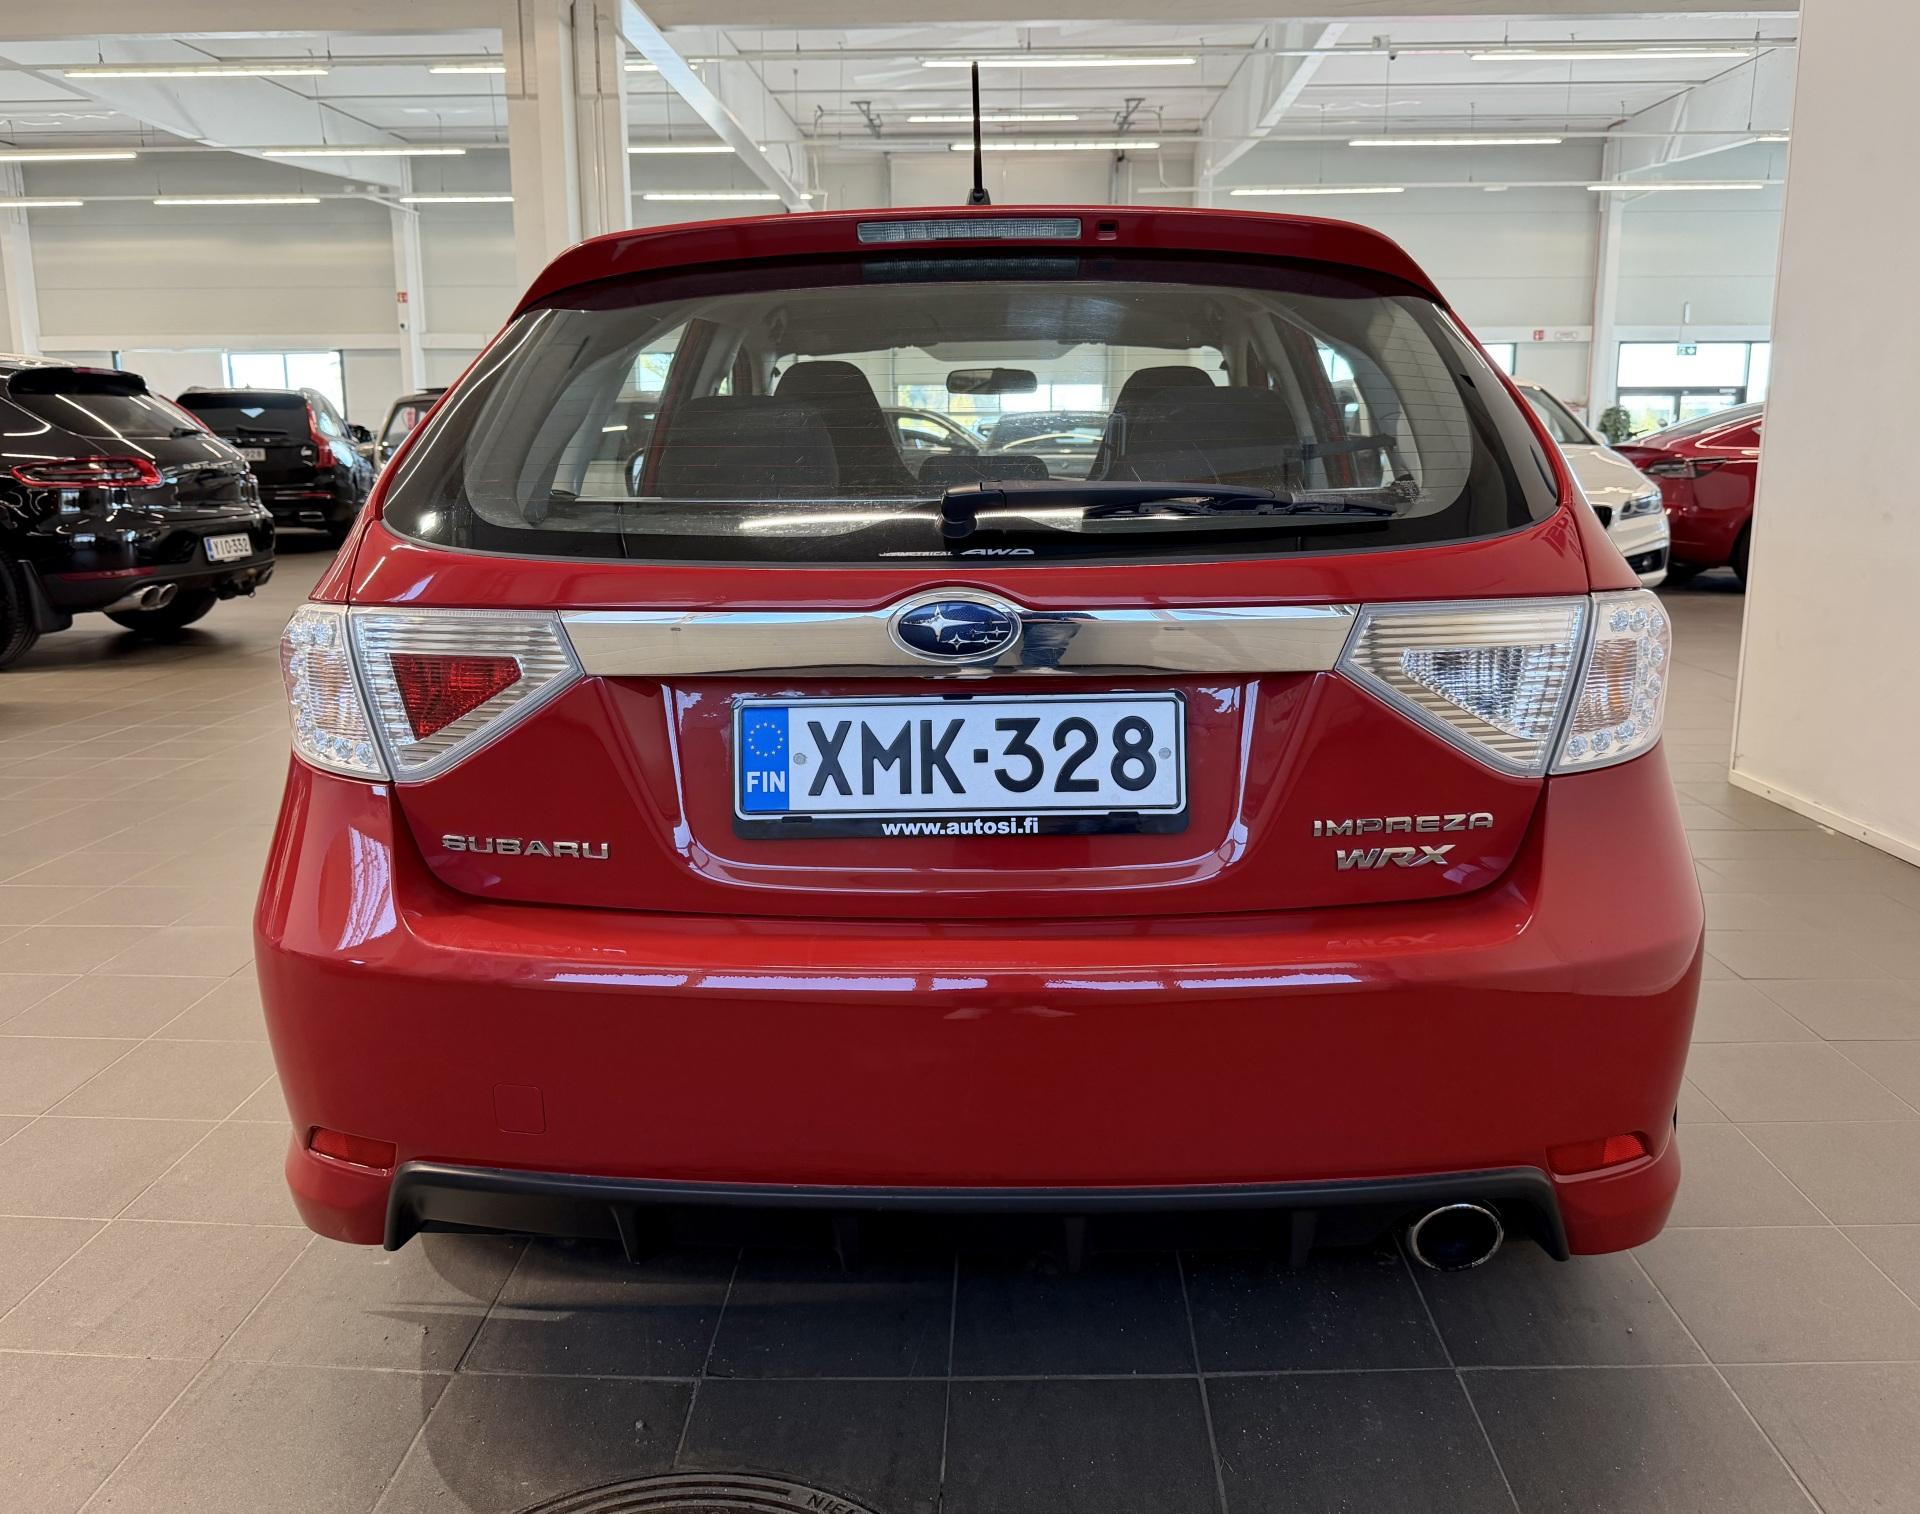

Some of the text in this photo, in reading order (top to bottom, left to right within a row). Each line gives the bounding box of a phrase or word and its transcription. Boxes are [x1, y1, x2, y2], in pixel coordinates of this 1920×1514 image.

[960, 548, 1035, 556] AWD
[807, 715, 1158, 796] XMK-328
[746, 770, 786, 793] FIN
[882, 817, 1040, 836] www.autosi.fi
[1313, 812, 1494, 837] IMPREZA
[442, 834, 610, 860] SUBARU
[1336, 844, 1457, 872] WRX
